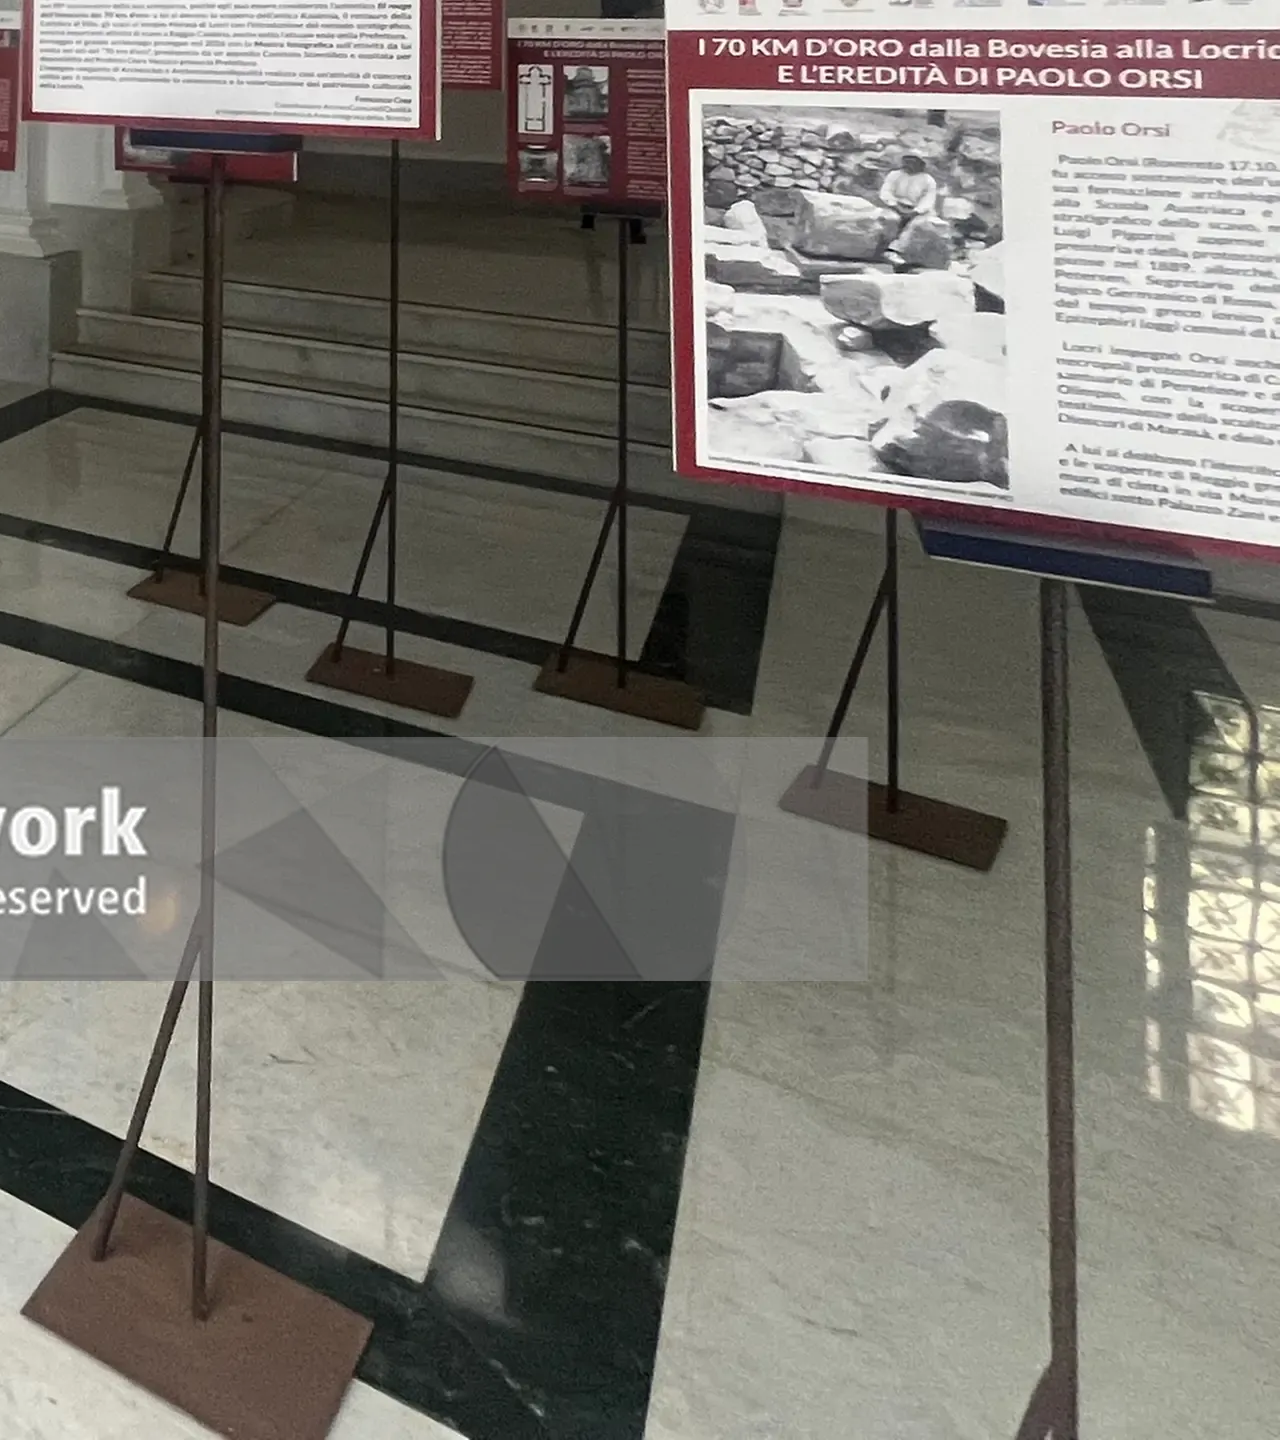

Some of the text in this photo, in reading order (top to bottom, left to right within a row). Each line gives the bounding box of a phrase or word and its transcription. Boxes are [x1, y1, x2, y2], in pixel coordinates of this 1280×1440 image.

[698, 37, 706, 56] I
[711, 37, 746, 56] 70
[751, 37, 799, 57] KM
[804, 37, 904, 57] D'ORO
[908, 37, 981, 58] dalla
[987, 38, 1109, 59] Bovesia
[1113, 38, 1174, 59] alla
[777, 62, 1203, 90] E L'EREDITÀ DI PAOLO ORSI
[1051, 119, 1170, 138] Paolo Orsi
